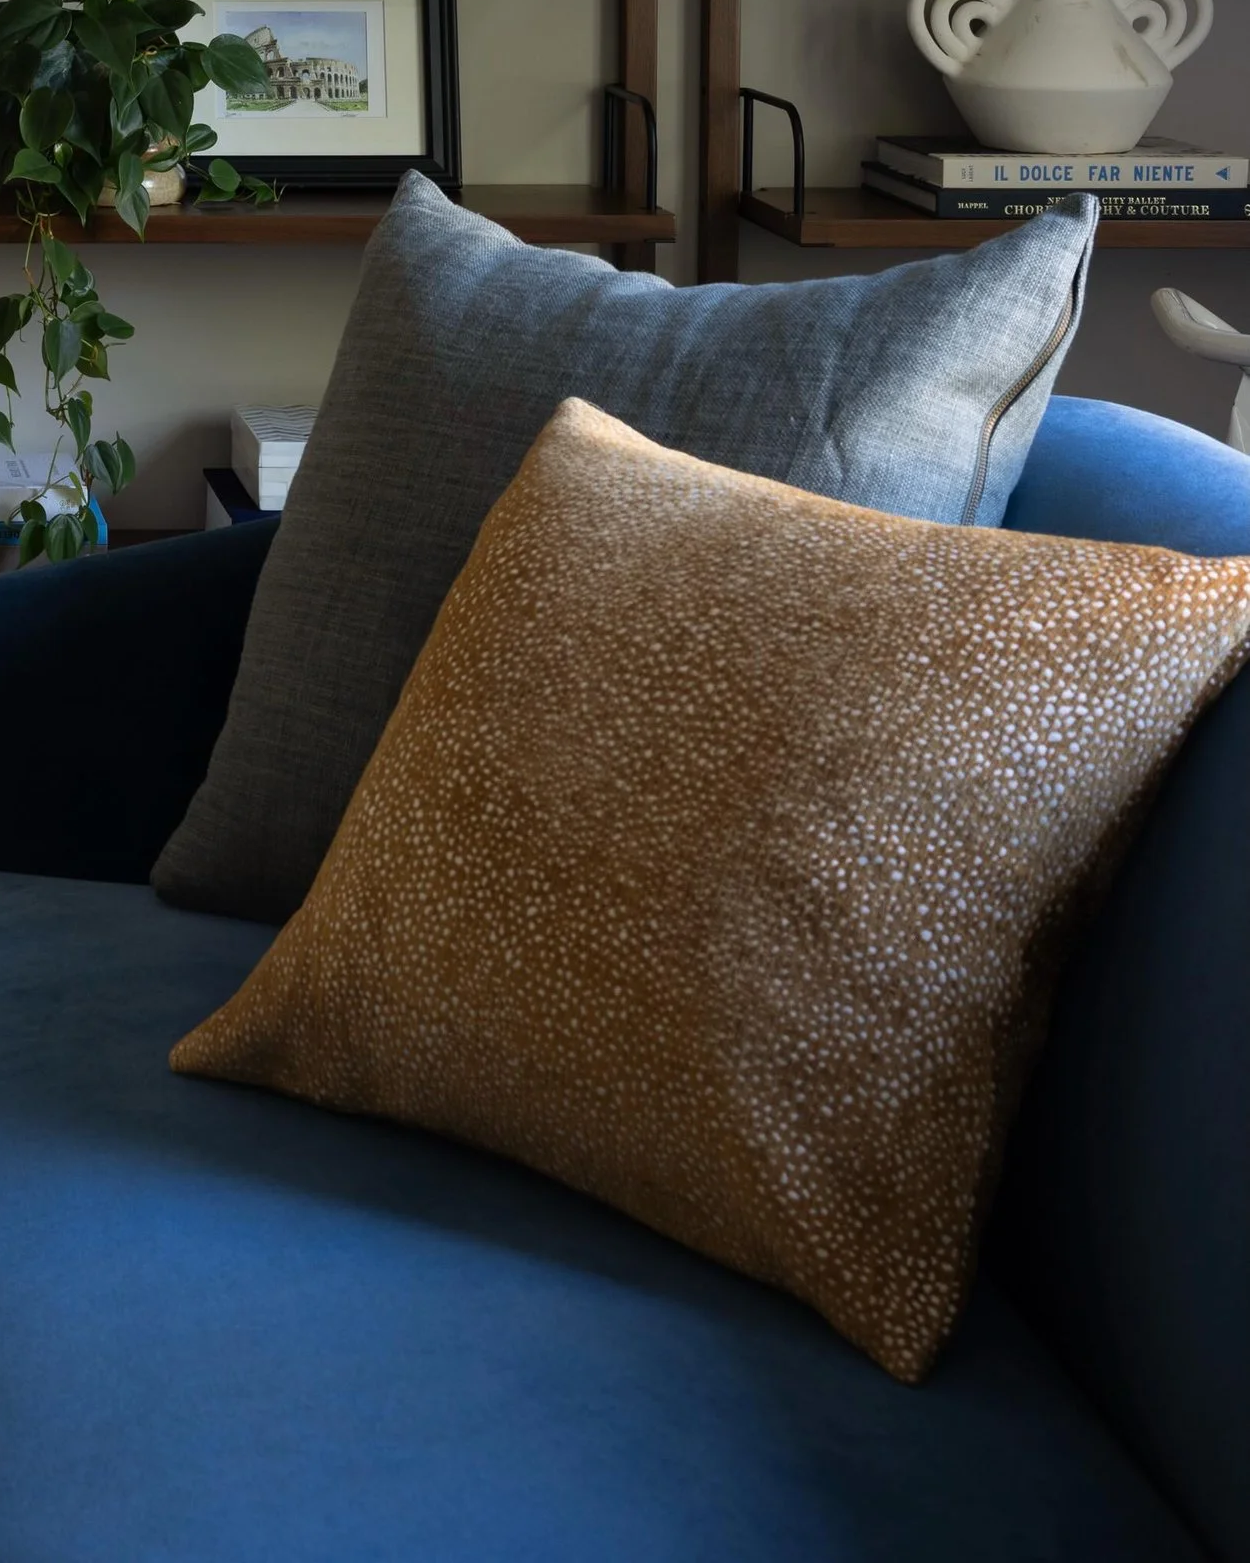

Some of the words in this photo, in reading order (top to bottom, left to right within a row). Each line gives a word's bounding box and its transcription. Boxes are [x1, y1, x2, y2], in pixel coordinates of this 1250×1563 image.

[994, 165, 1008, 181] IL
[1020, 165, 1073, 181] DOLCE
[1088, 165, 1120, 181] FAR
[1133, 165, 1195, 182] NIENTE
[957, 201, 989, 210] HAPPEL
[1047, 197, 1065, 205] NE
[1102, 197, 1126, 205] CITY
[1128, 197, 1166, 205] BALLET
[1126, 205, 1137, 216] &
[1140, 205, 1210, 215] COUTURE
